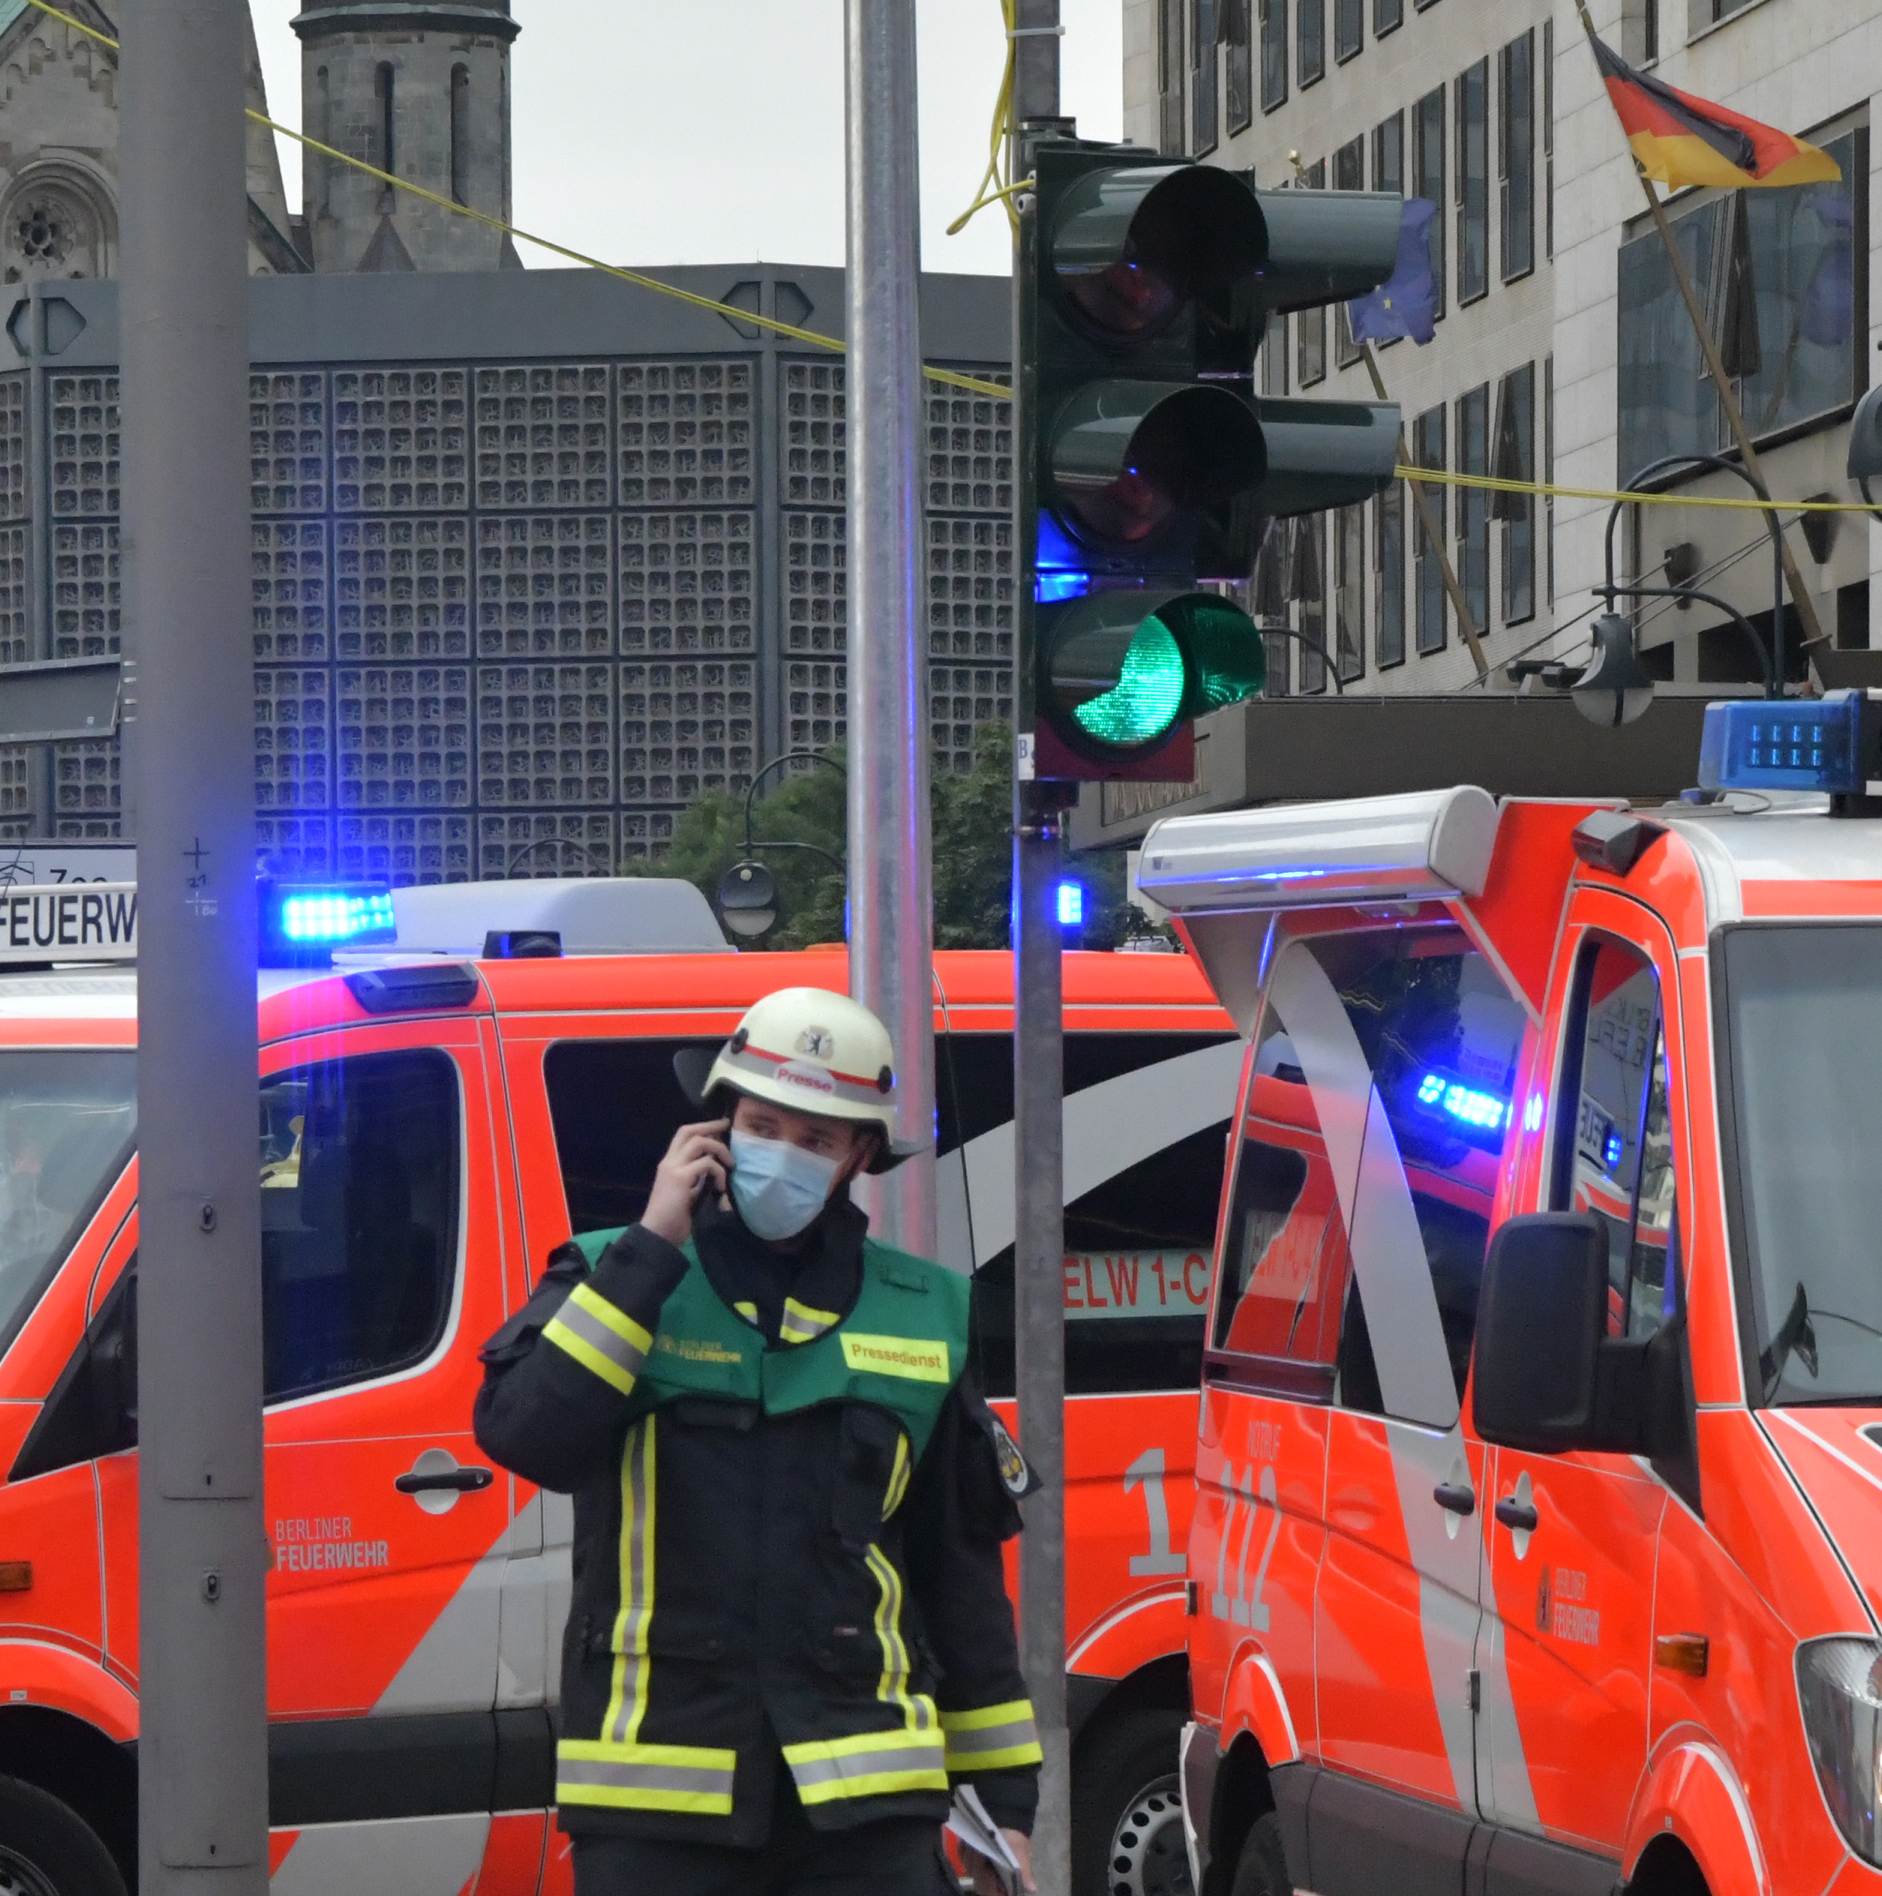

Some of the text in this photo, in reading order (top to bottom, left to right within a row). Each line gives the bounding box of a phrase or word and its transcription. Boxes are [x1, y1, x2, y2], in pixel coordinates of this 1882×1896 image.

[777, 1068, 832, 1093] Presse
[1063, 1256, 1139, 1309] ELW
[851, 1343, 941, 1369] Pressedienst
[274, 1516, 352, 1541] BERLINER
[276, 1539, 390, 1572] FEUERWEHR
[1211, 1459, 1283, 1634] 112
